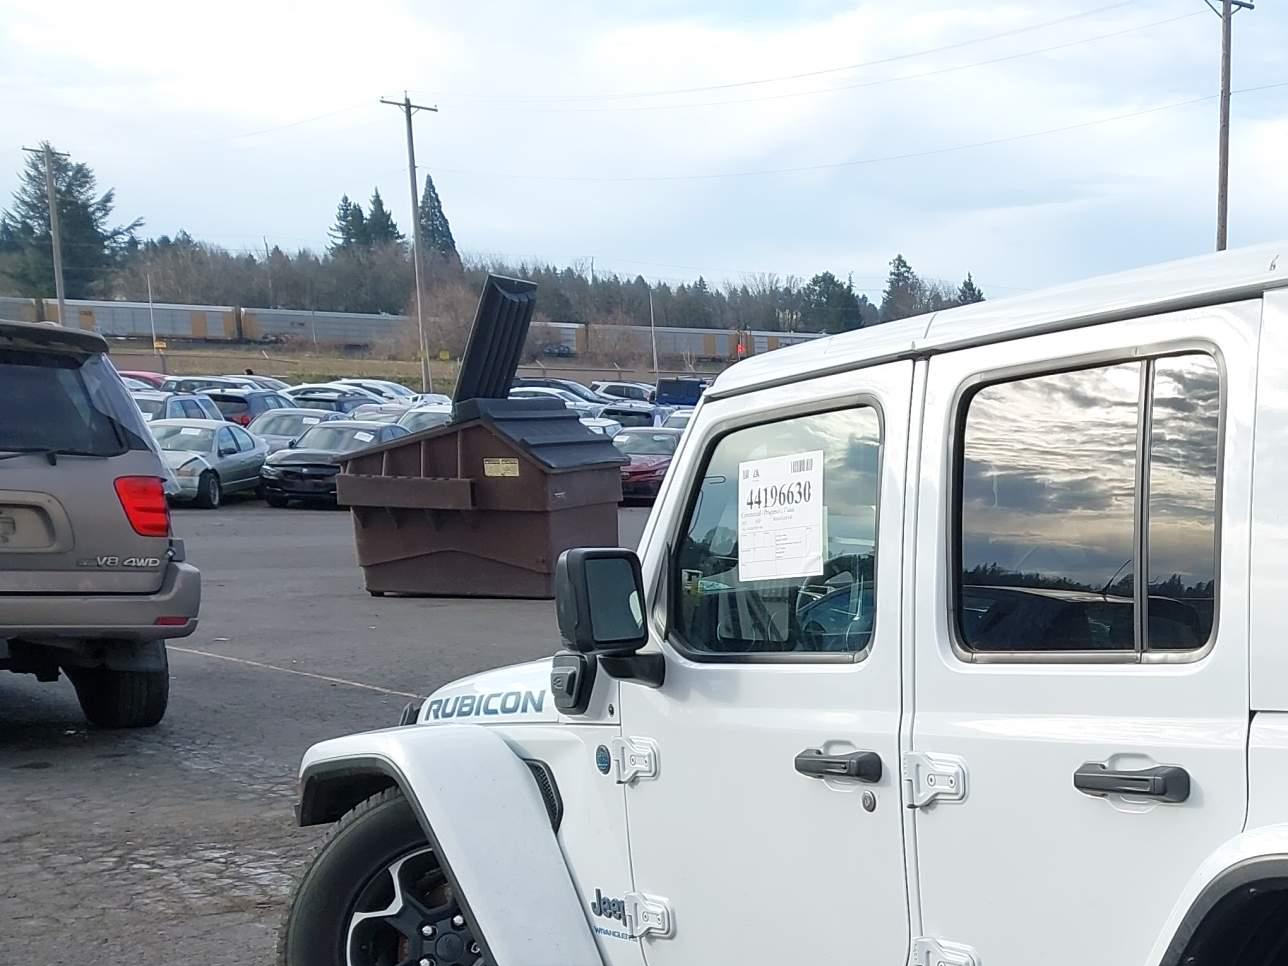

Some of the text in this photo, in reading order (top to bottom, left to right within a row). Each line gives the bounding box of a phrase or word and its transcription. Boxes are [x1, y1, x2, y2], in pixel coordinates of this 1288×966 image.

[747, 481, 811, 510] 44196630
[96, 556, 118, 567] V8
[122, 558, 161, 567] 4WD
[424, 689, 546, 721] RUBICON
[595, 925, 637, 943] WRANGLE
